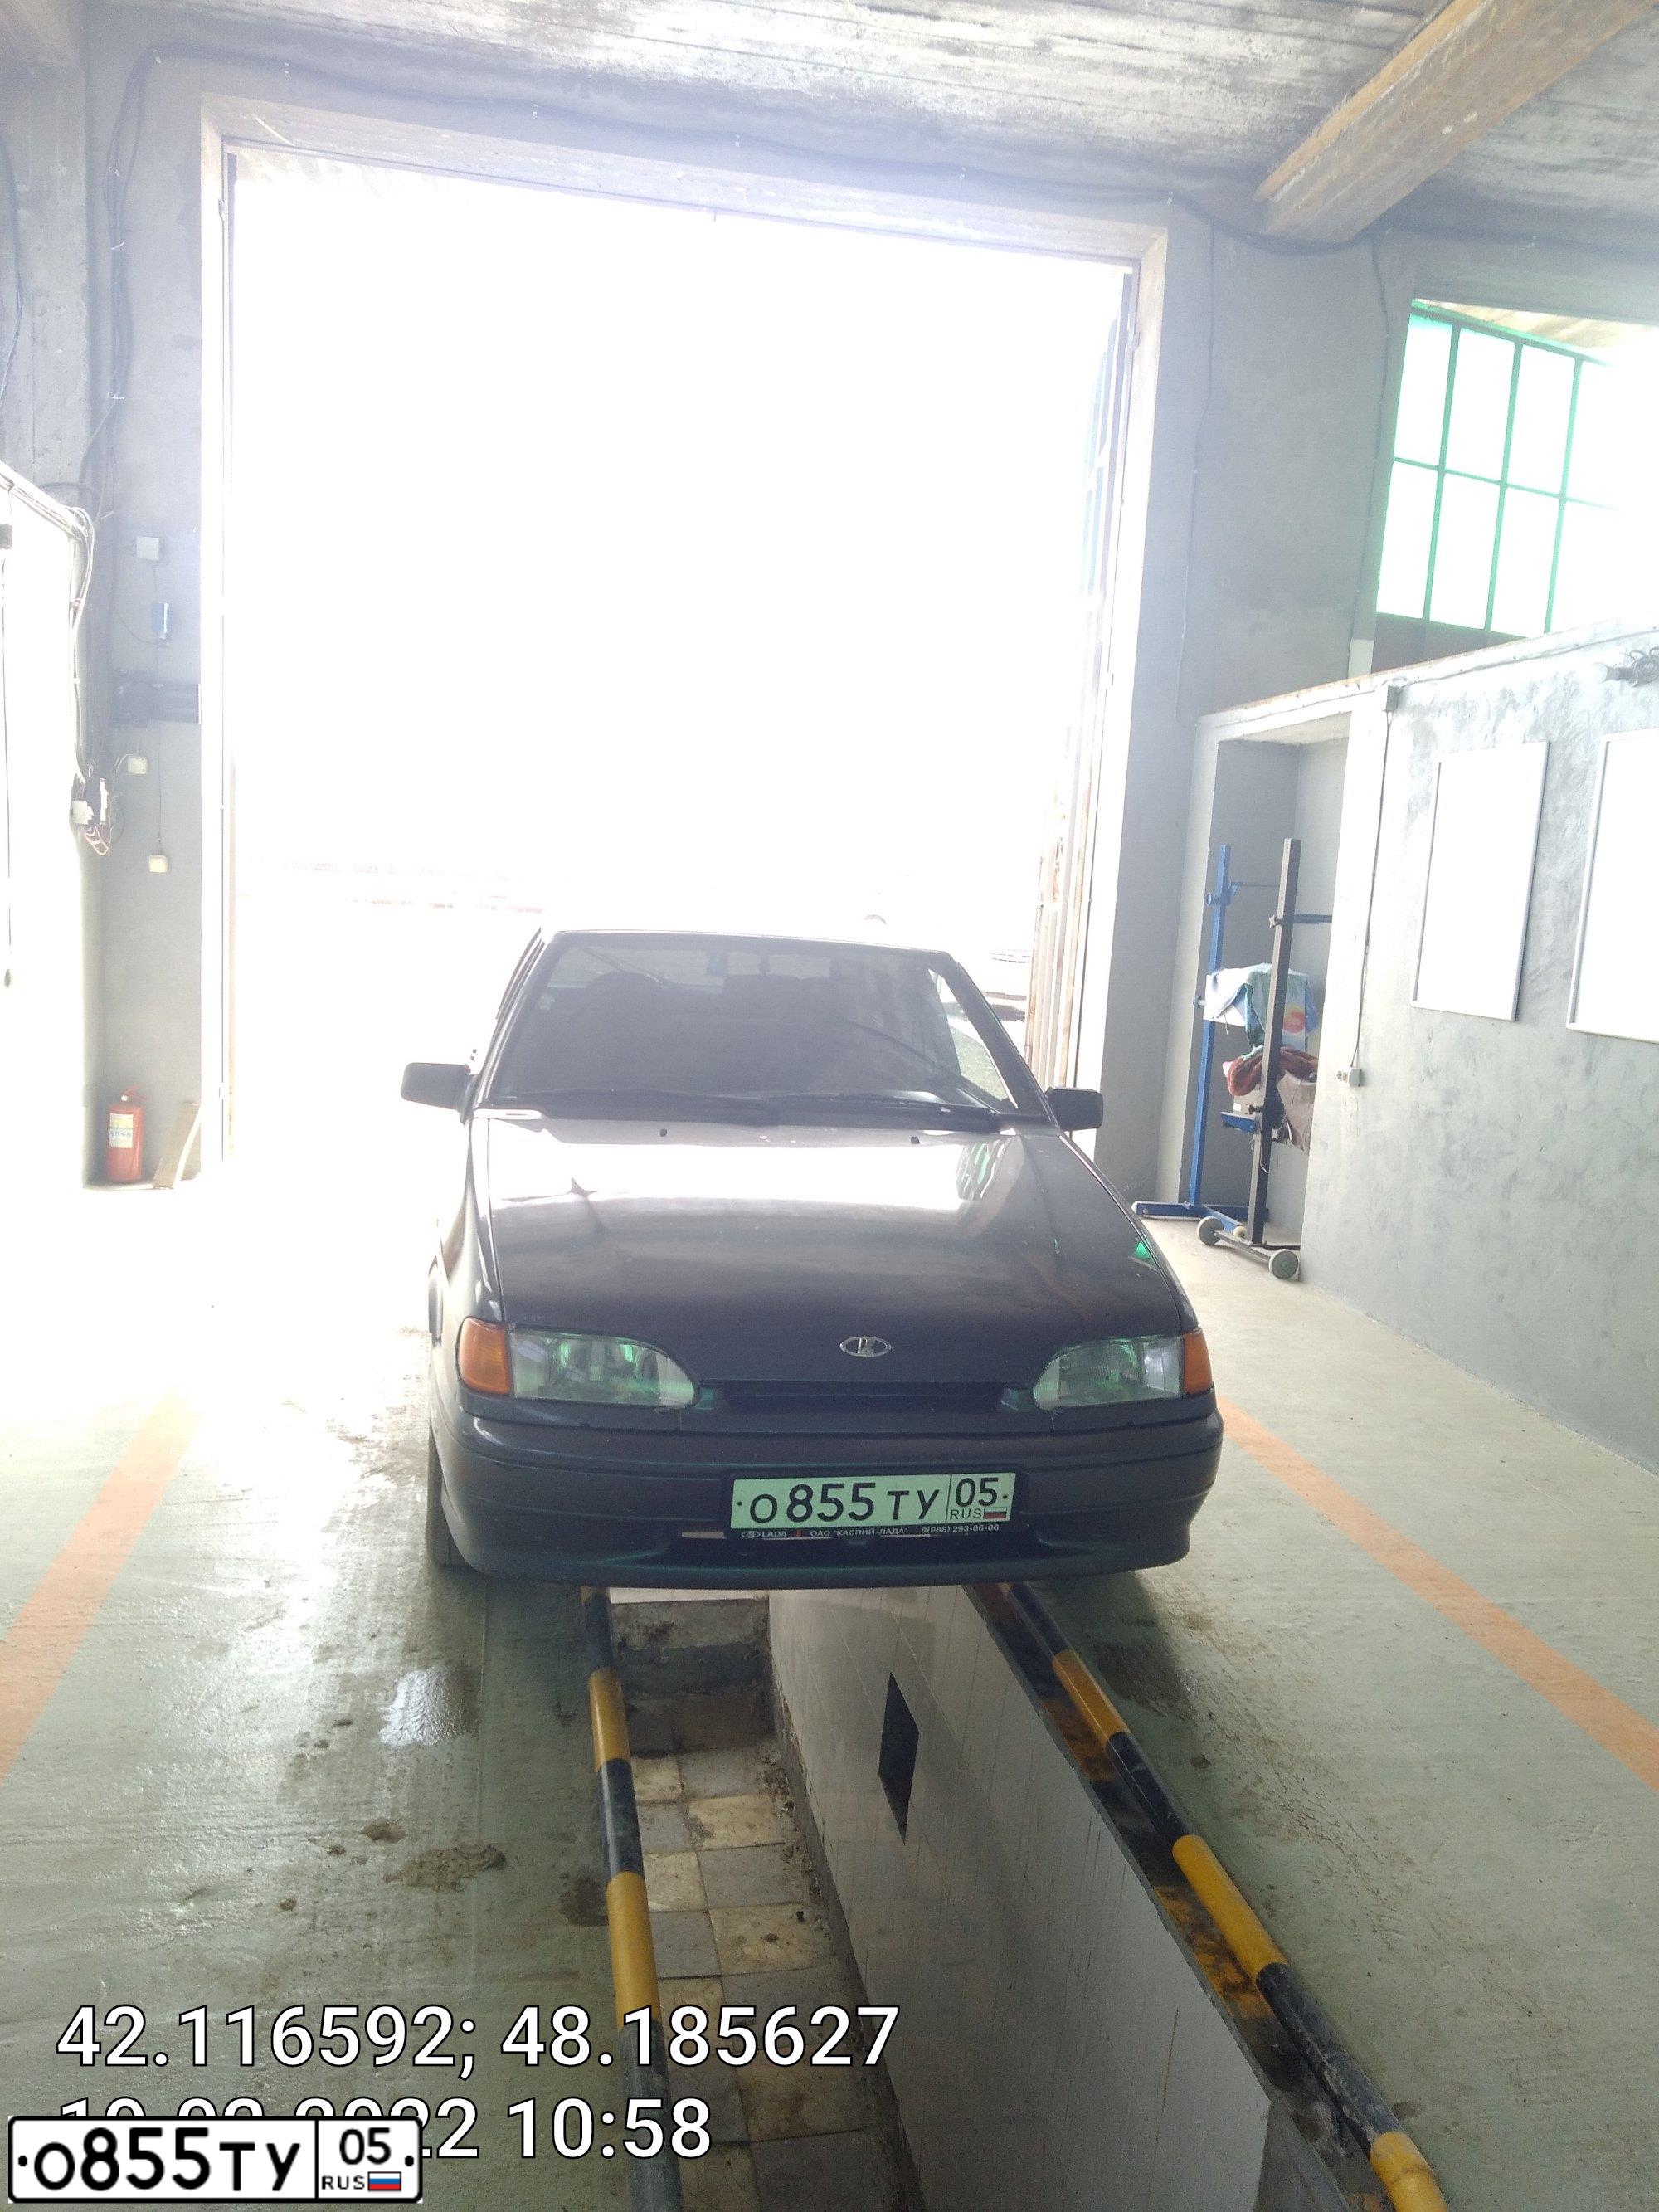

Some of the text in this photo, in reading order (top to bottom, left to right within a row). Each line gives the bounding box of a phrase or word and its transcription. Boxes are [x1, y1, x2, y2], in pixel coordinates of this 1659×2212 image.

[955, 1477, 1000, 1508] 05
[950, 1508, 981, 1520] RUS
[761, 1530, 787, 1538] LADA
